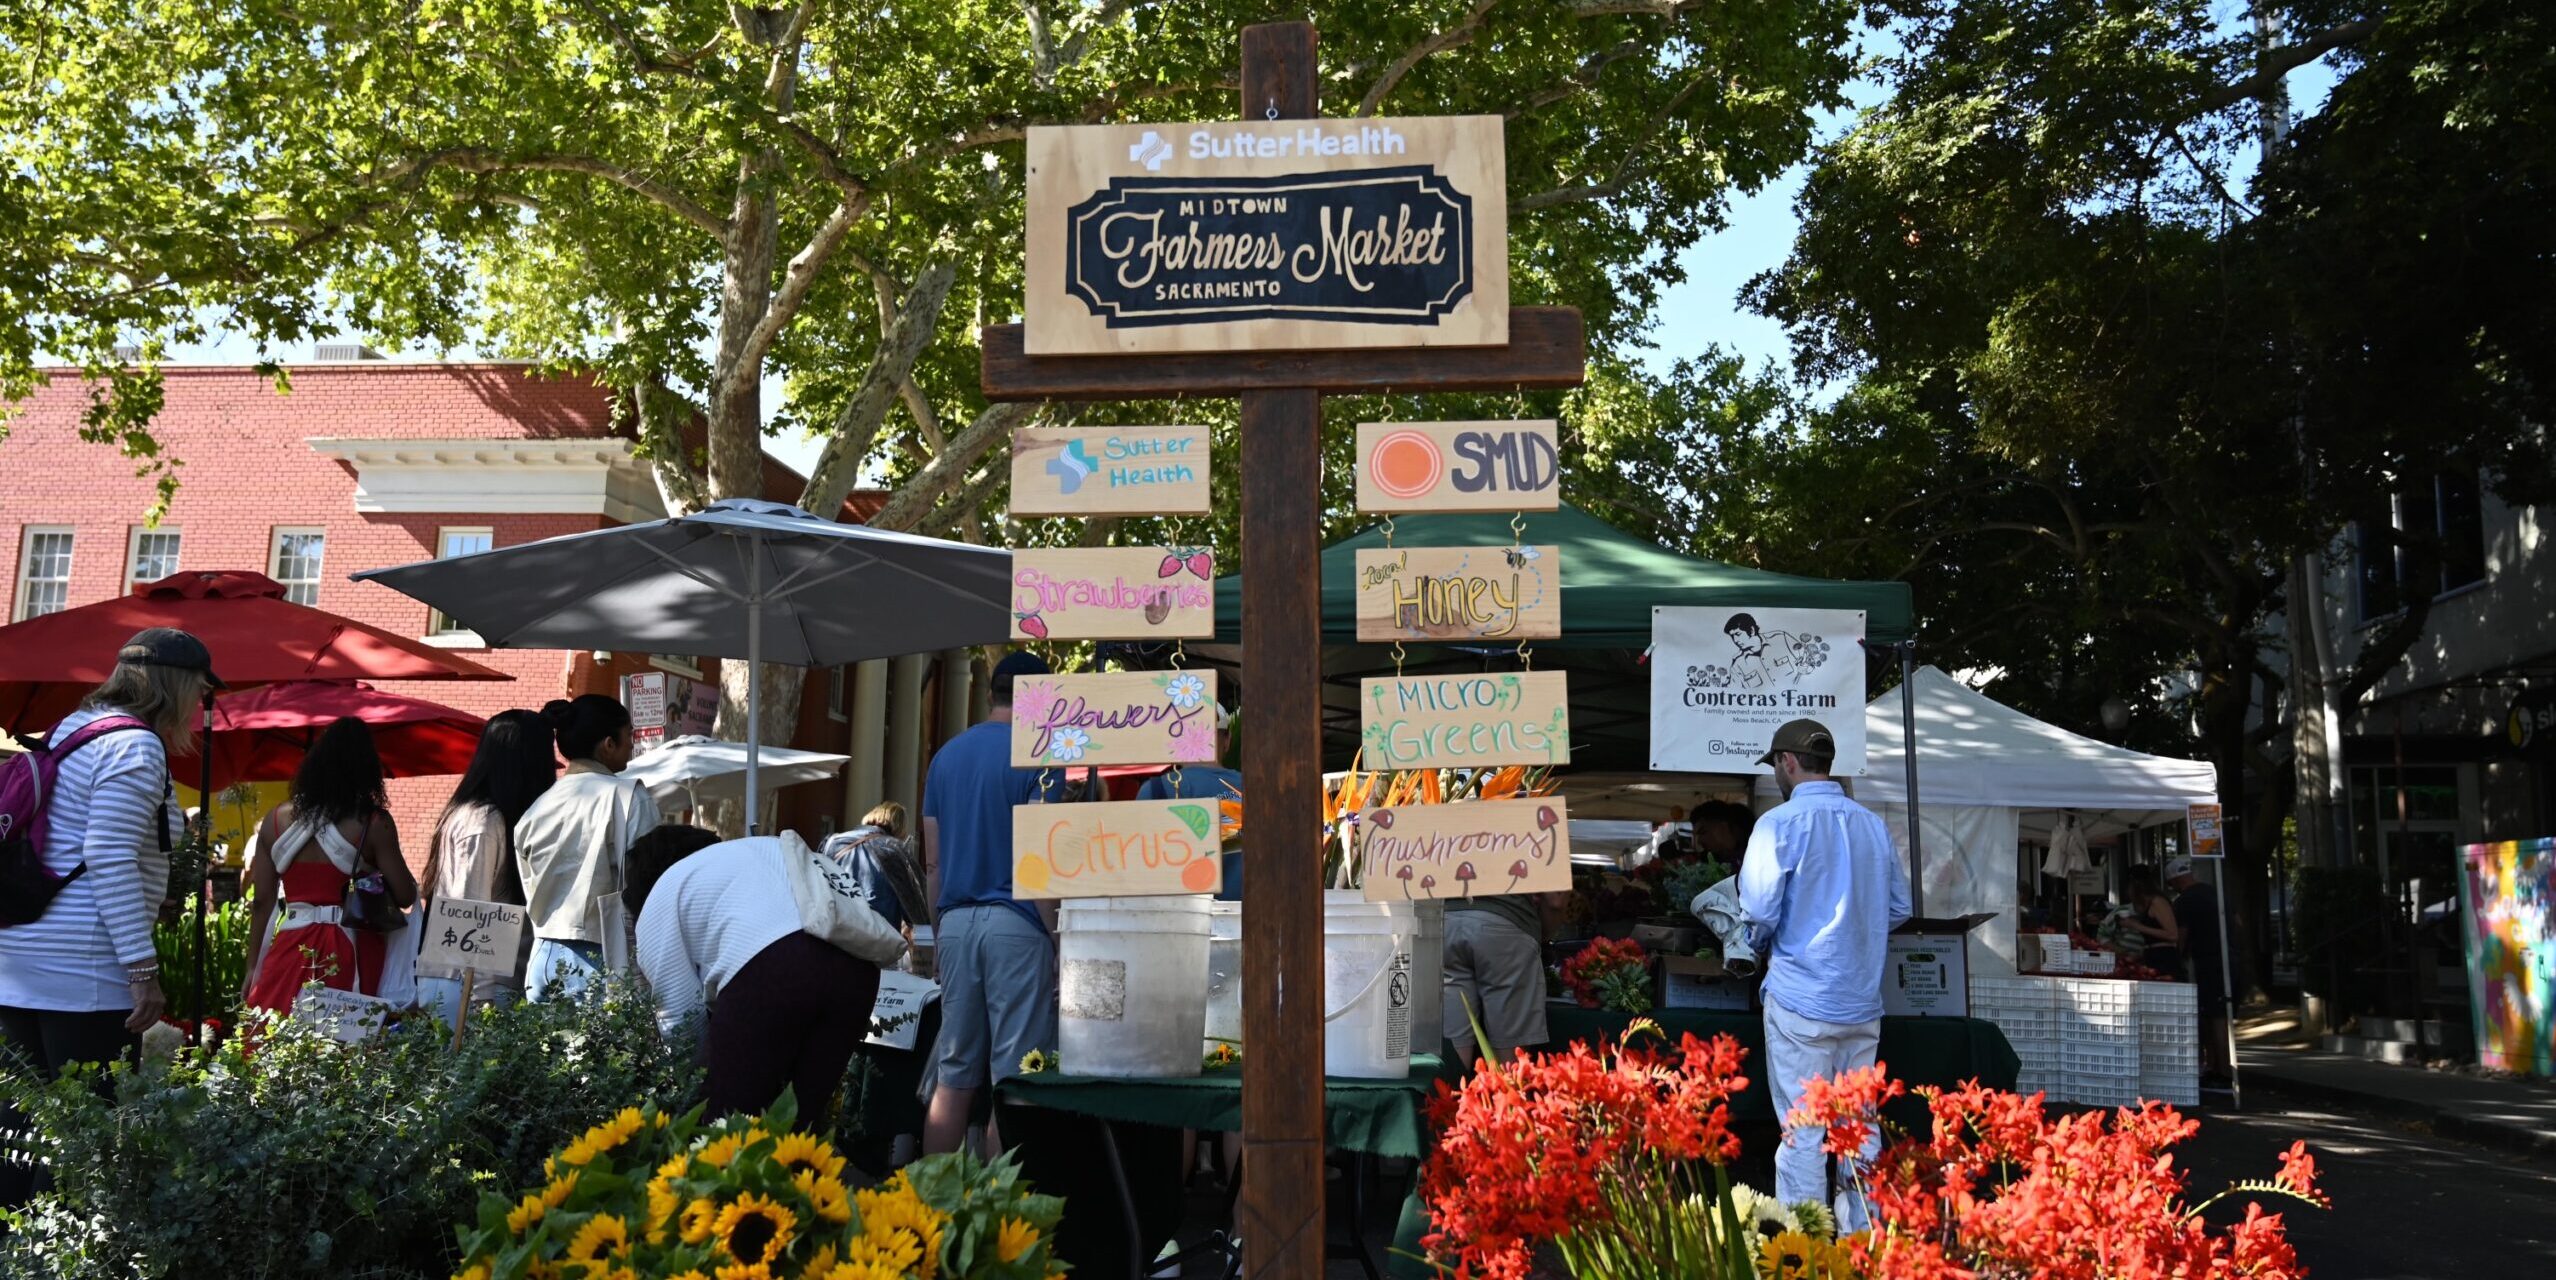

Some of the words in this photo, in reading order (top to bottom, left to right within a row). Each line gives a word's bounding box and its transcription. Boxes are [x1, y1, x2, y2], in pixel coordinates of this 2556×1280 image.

[1188, 130, 1293, 159] Sutter
[1296, 126, 1406, 157] Health
[1180, 198, 1287, 216] MIDTOWN
[1100, 208, 1286, 289] Farmers
[1291, 203, 1446, 292] Market
[1155, 280, 1281, 300] SACRAMENTO
[1104, 436, 1193, 460] Sutter
[1451, 431, 1559, 492] SMUD
[1110, 464, 1193, 488] Health
[1014, 568, 1211, 613] Strawberries
[1393, 573, 1519, 637] Honey
[632, 676, 643, 687] NO
[632, 687, 663, 696] PARKING
[1683, 687, 1777, 707] Contreras
[1781, 689, 1836, 708] Farm
[1031, 696, 1204, 758] flowers
[1388, 720, 1550, 762] Greens
[1725, 746, 1765, 758] Instagram
[1048, 818, 1193, 879] Citrus
[440, 901, 520, 929] Eucalyptus
